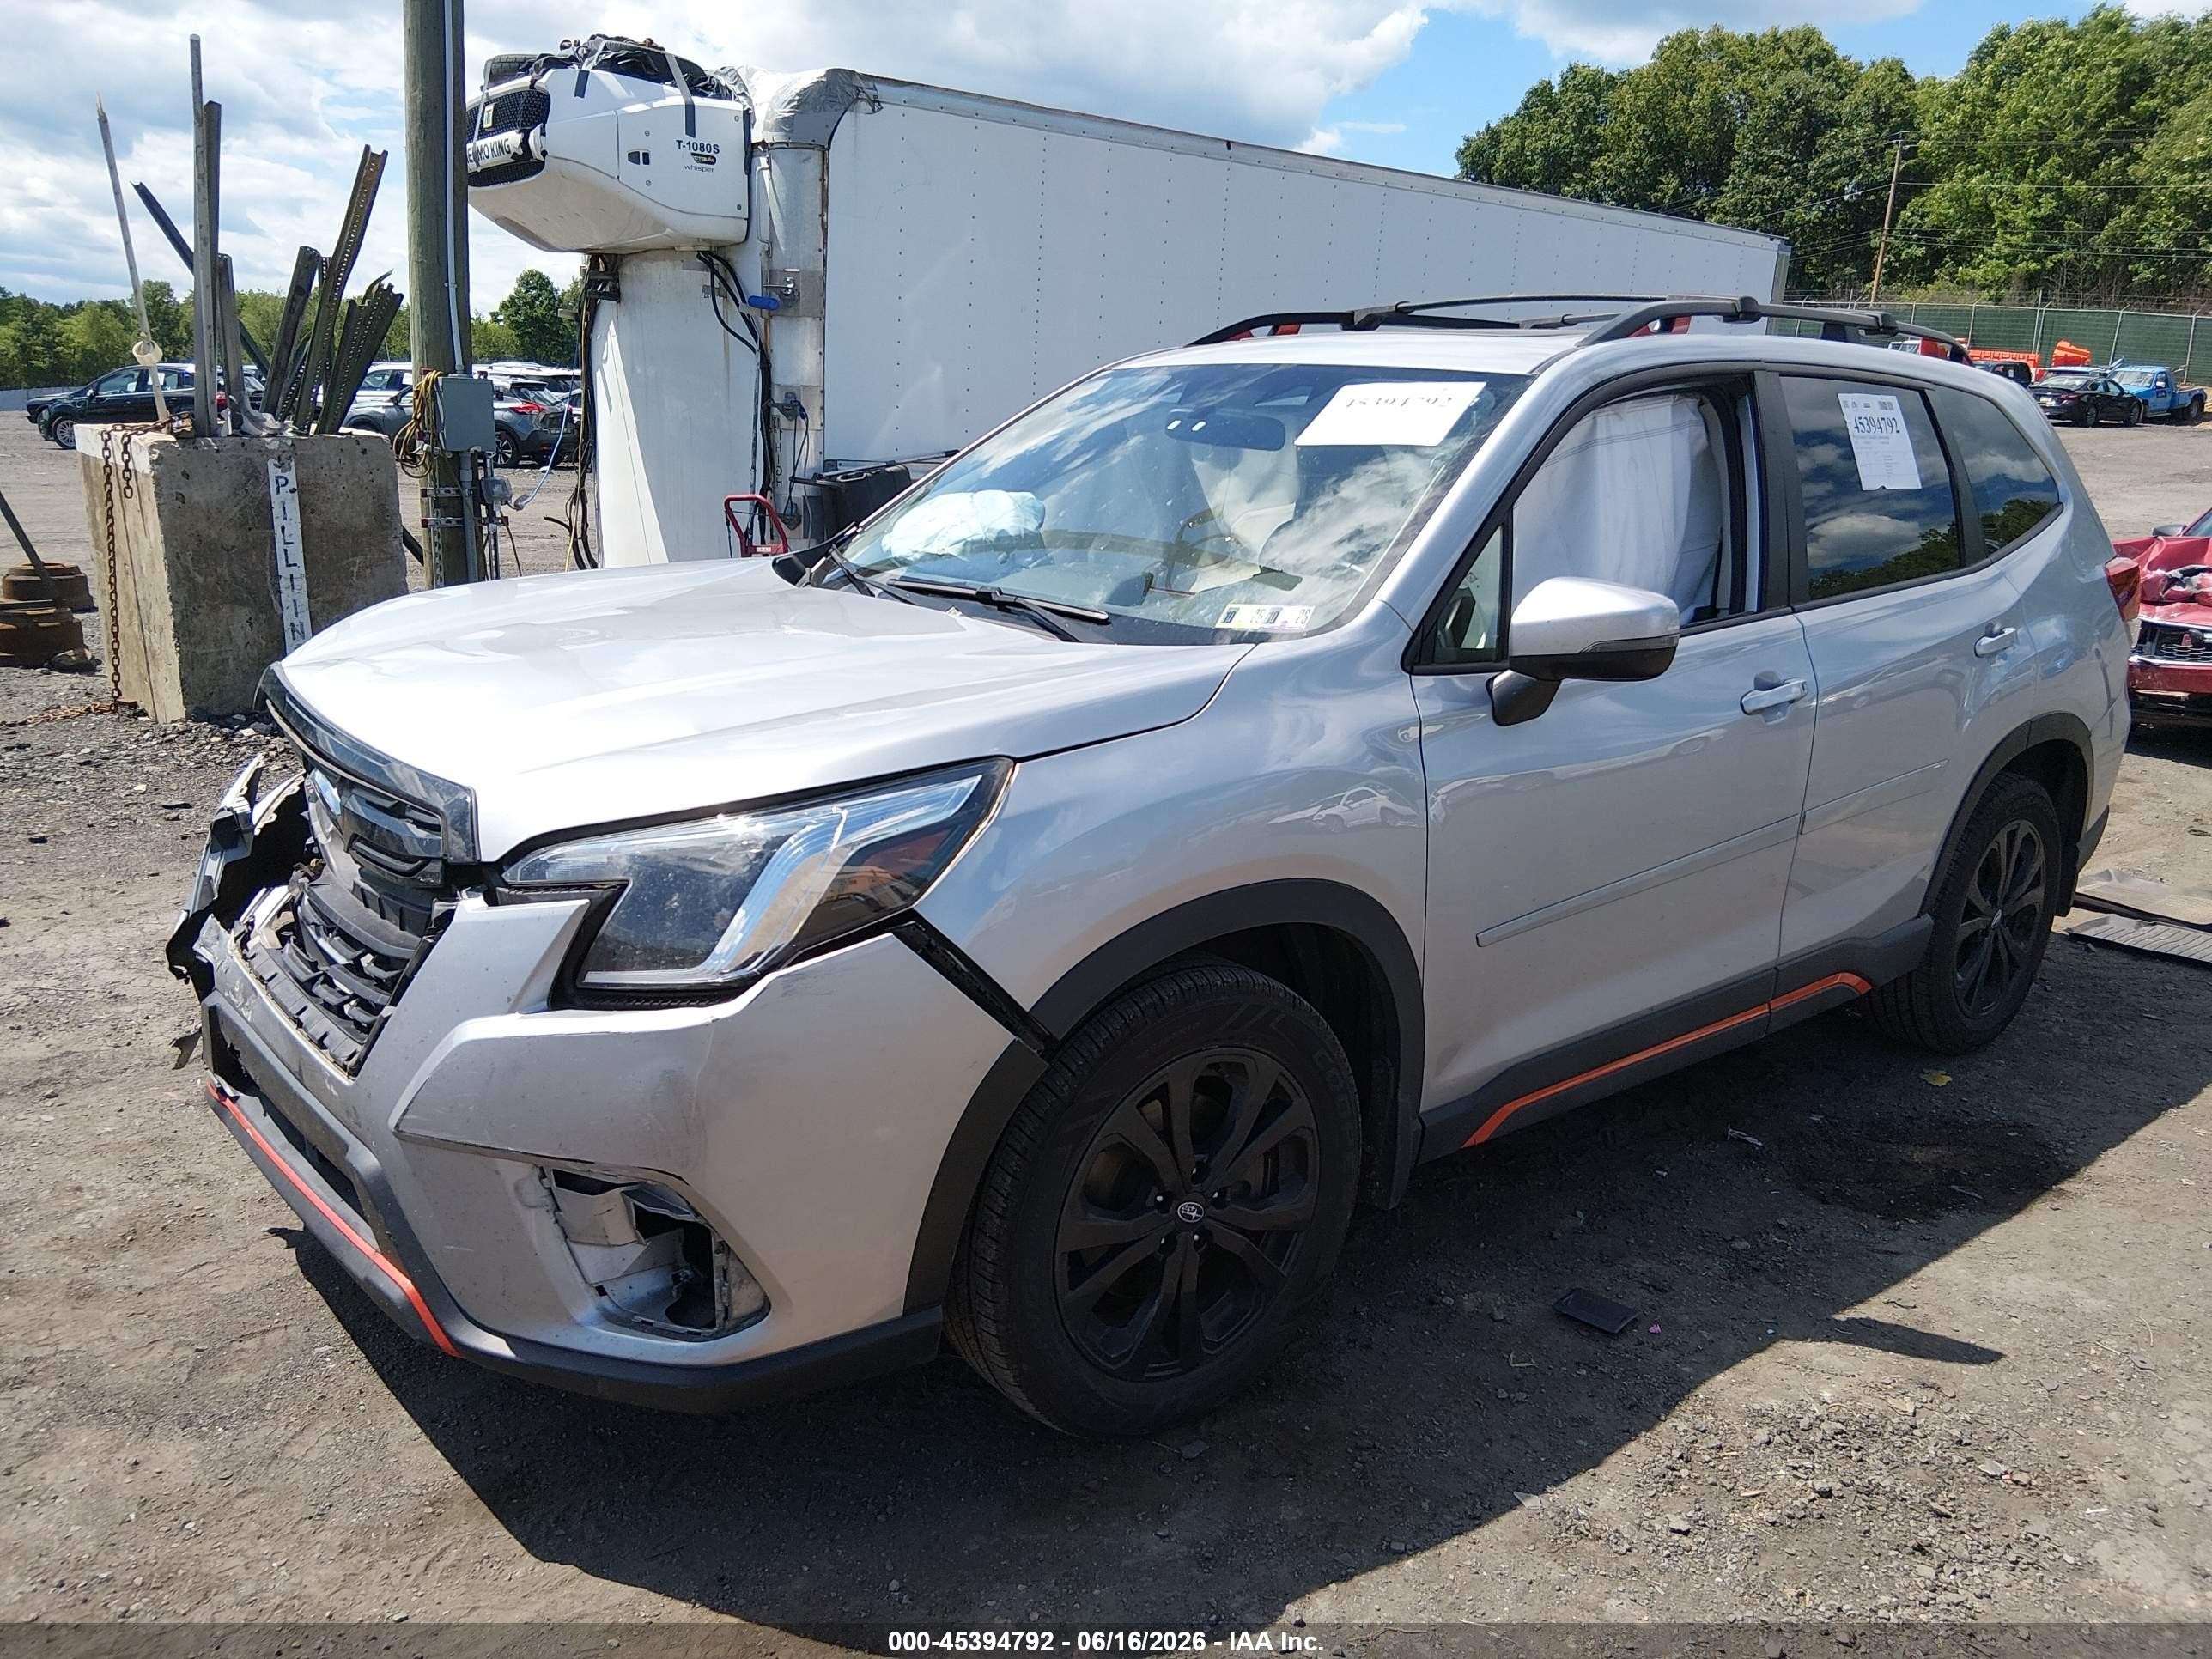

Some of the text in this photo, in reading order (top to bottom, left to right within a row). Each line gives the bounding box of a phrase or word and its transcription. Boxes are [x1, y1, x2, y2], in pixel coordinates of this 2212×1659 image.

[490, 138, 512, 160] KING
[676, 140, 720, 155] T-1080S
[1854, 416, 1900, 434] 45394792
